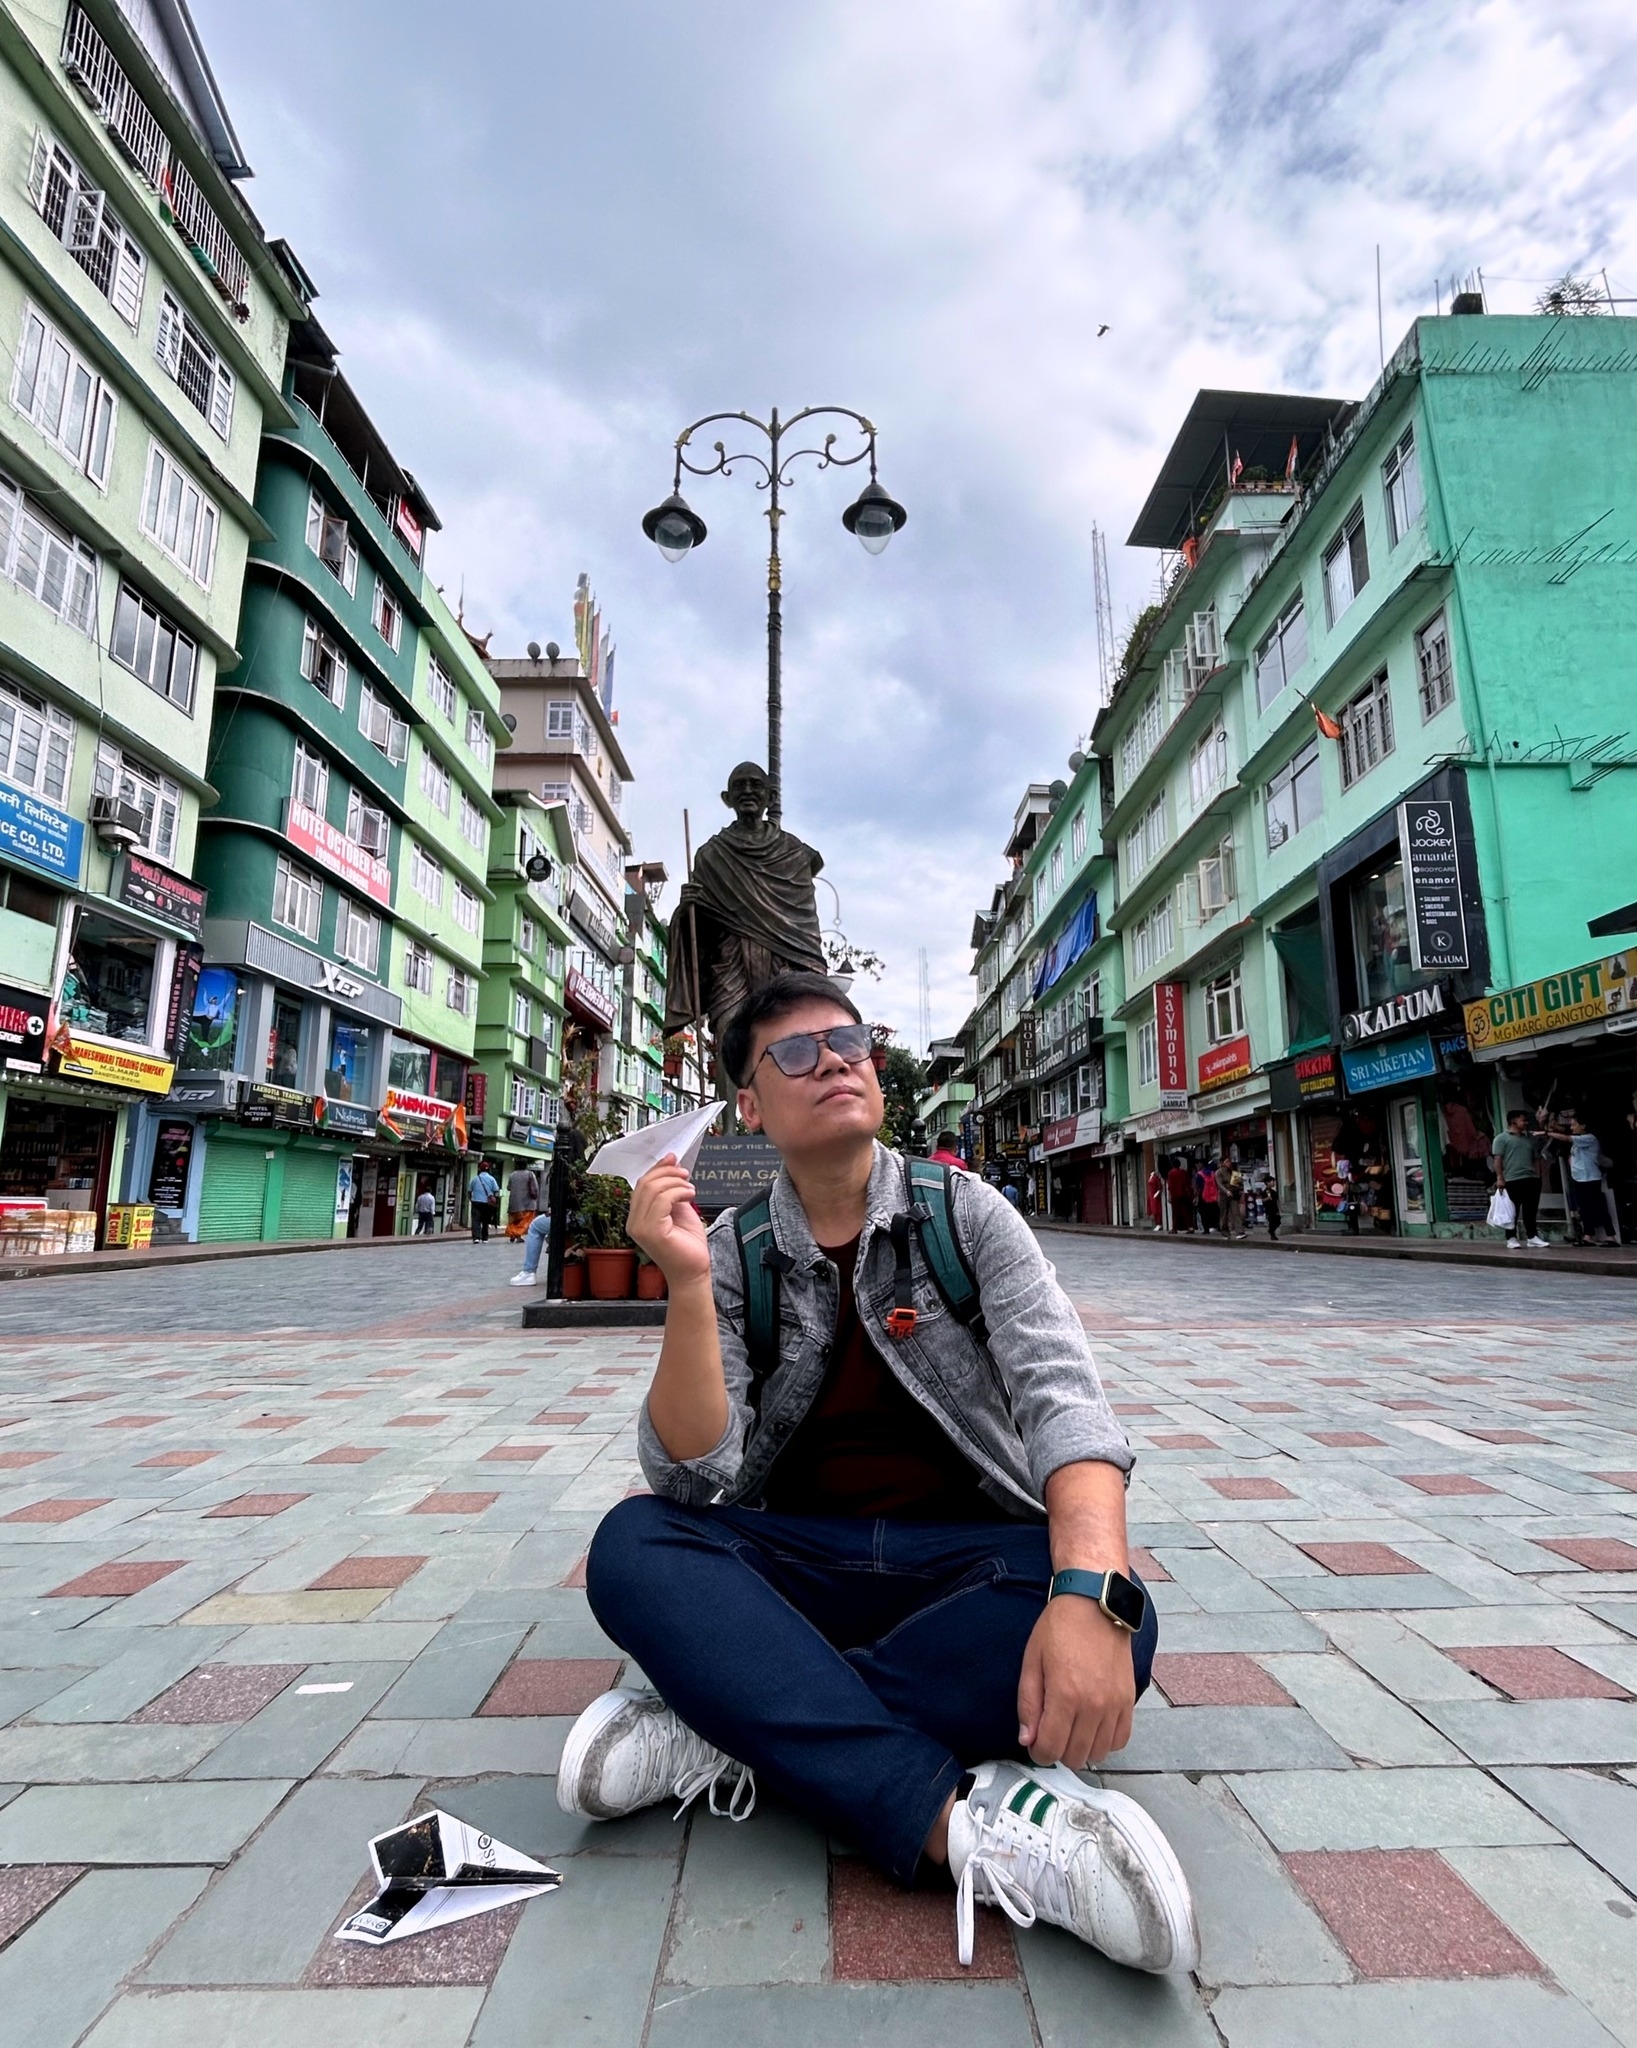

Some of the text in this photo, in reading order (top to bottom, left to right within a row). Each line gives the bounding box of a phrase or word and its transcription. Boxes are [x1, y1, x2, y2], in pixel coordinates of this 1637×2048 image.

[24, 800, 68, 833] लिमिटेड
[0, 820, 65, 860] CE CO. LTD.
[12, 839, 65, 868] Gangtok Branch
[292, 801, 388, 889] HOTEL OCTOBER SKY
[1412, 838, 1452, 847] JOCKEY
[1412, 849, 1455, 861] amanté
[131, 858, 160, 884] WORLD
[160, 875, 203, 906] ADVENTURE
[1489, 964, 1602, 1028] CITI GIFT
[1546, 1001, 1603, 1028] GANGTOK
[1023, 1023, 1033, 1067] HOTEL
[1165, 985, 1177, 1085] Raymond
[115, 1056, 140, 1070] TRADING
[140, 1062, 165, 1077] COMPANY
[1295, 1053, 1332, 1079] SIKKIM
[1351, 1064, 1369, 1082] SRI
[1371, 1047, 1426, 1075] NIKETAN
[691, 1170, 779, 1180] HATMA GA
